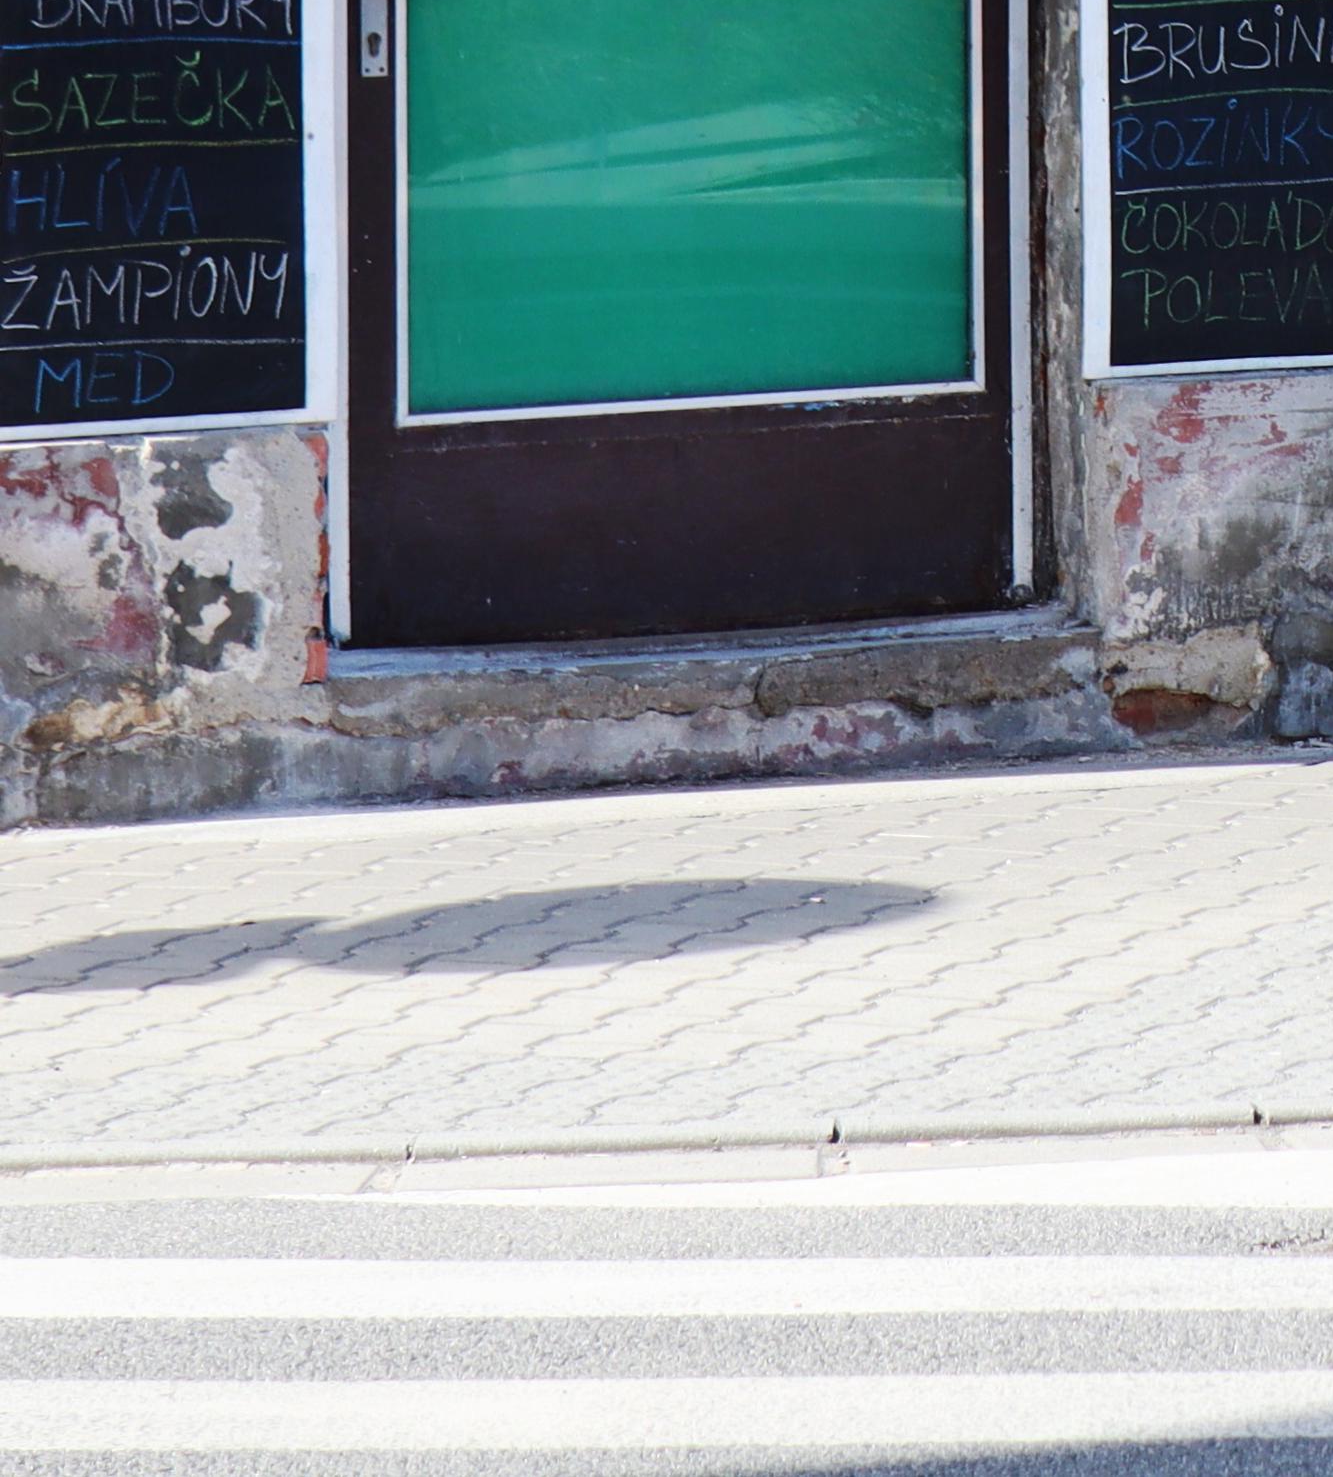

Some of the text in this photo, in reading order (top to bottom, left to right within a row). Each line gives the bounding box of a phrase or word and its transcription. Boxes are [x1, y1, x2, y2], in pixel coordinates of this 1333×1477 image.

[2, 50, 297, 136] SAZEČKA
[7, 157, 200, 237] HLÍVA
[1, 245, 290, 331] ŽAMPIONY
[1120, 263, 1332, 331] POLEVA
[34, 352, 175, 414] MED
